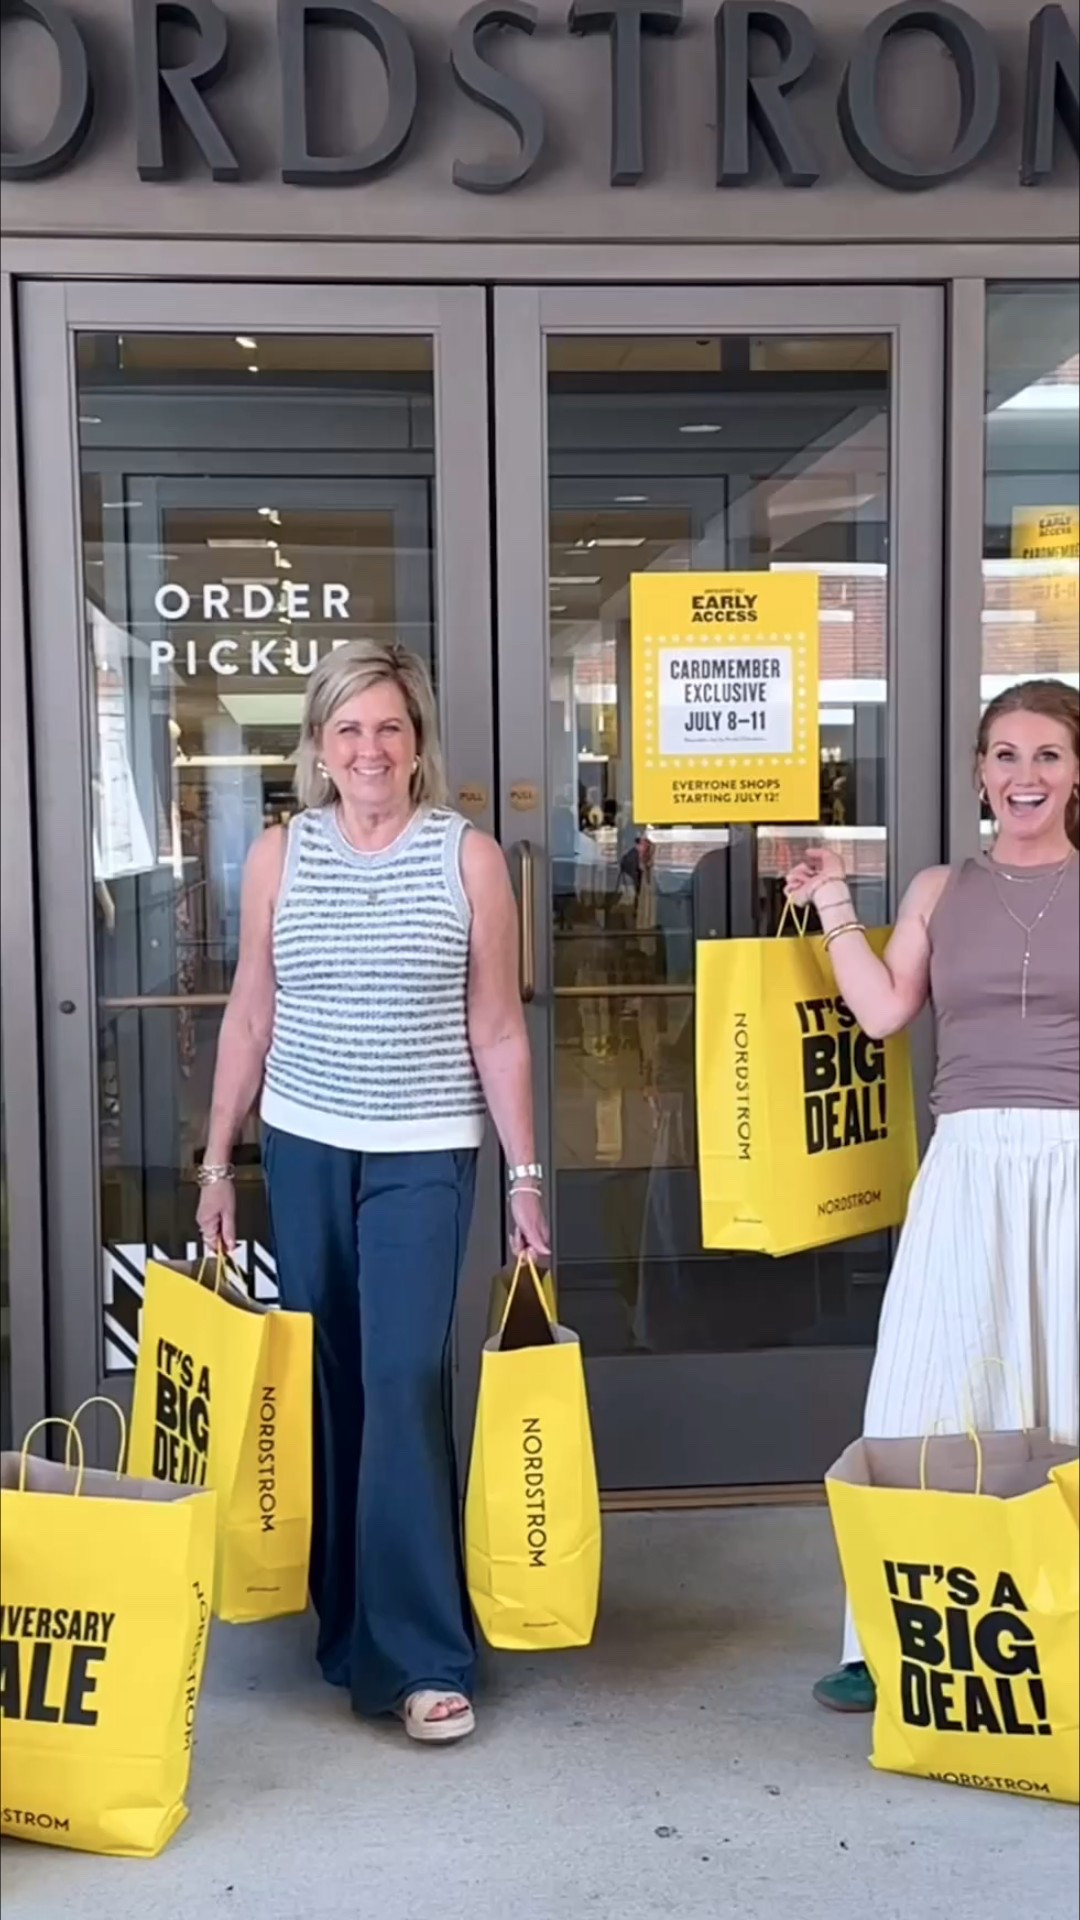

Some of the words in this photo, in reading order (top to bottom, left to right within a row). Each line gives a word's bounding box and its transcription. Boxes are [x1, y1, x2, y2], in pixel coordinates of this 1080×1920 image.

[154, 583, 350, 619] ORDER
[691, 595, 758, 609] EARLY
[691, 610, 758, 622] ACCESS
[150, 639, 351, 675] PICKU
[670, 658, 780, 679] CARDMEMBER
[684, 683, 767, 703] EXCLUSIVE
[684, 711, 722, 731] JULY
[672, 780, 737, 791] EVERYONE
[739, 779, 780, 790] SHOPS
[673, 793, 732, 804] STARTING
[734, 793, 760, 803] JULY
[802, 1031, 886, 1093] BIG
[734, 1012, 751, 1160] NORDSTROM
[804, 1083, 888, 1155] DEAL!
[817, 1189, 882, 1216] NORDSTROM
[197, 1365, 211, 1402] A
[156, 1370, 210, 1458] BIG
[257, 1387, 276, 1532] NORDSTROM
[522, 1418, 547, 1568] NORDSTROM
[990, 1571, 1028, 1612] A
[891, 1597, 1040, 1676] BIG
[901, 1659, 1053, 1735] DEAL!
[928, 1772, 1050, 1793] NORDSTROM
